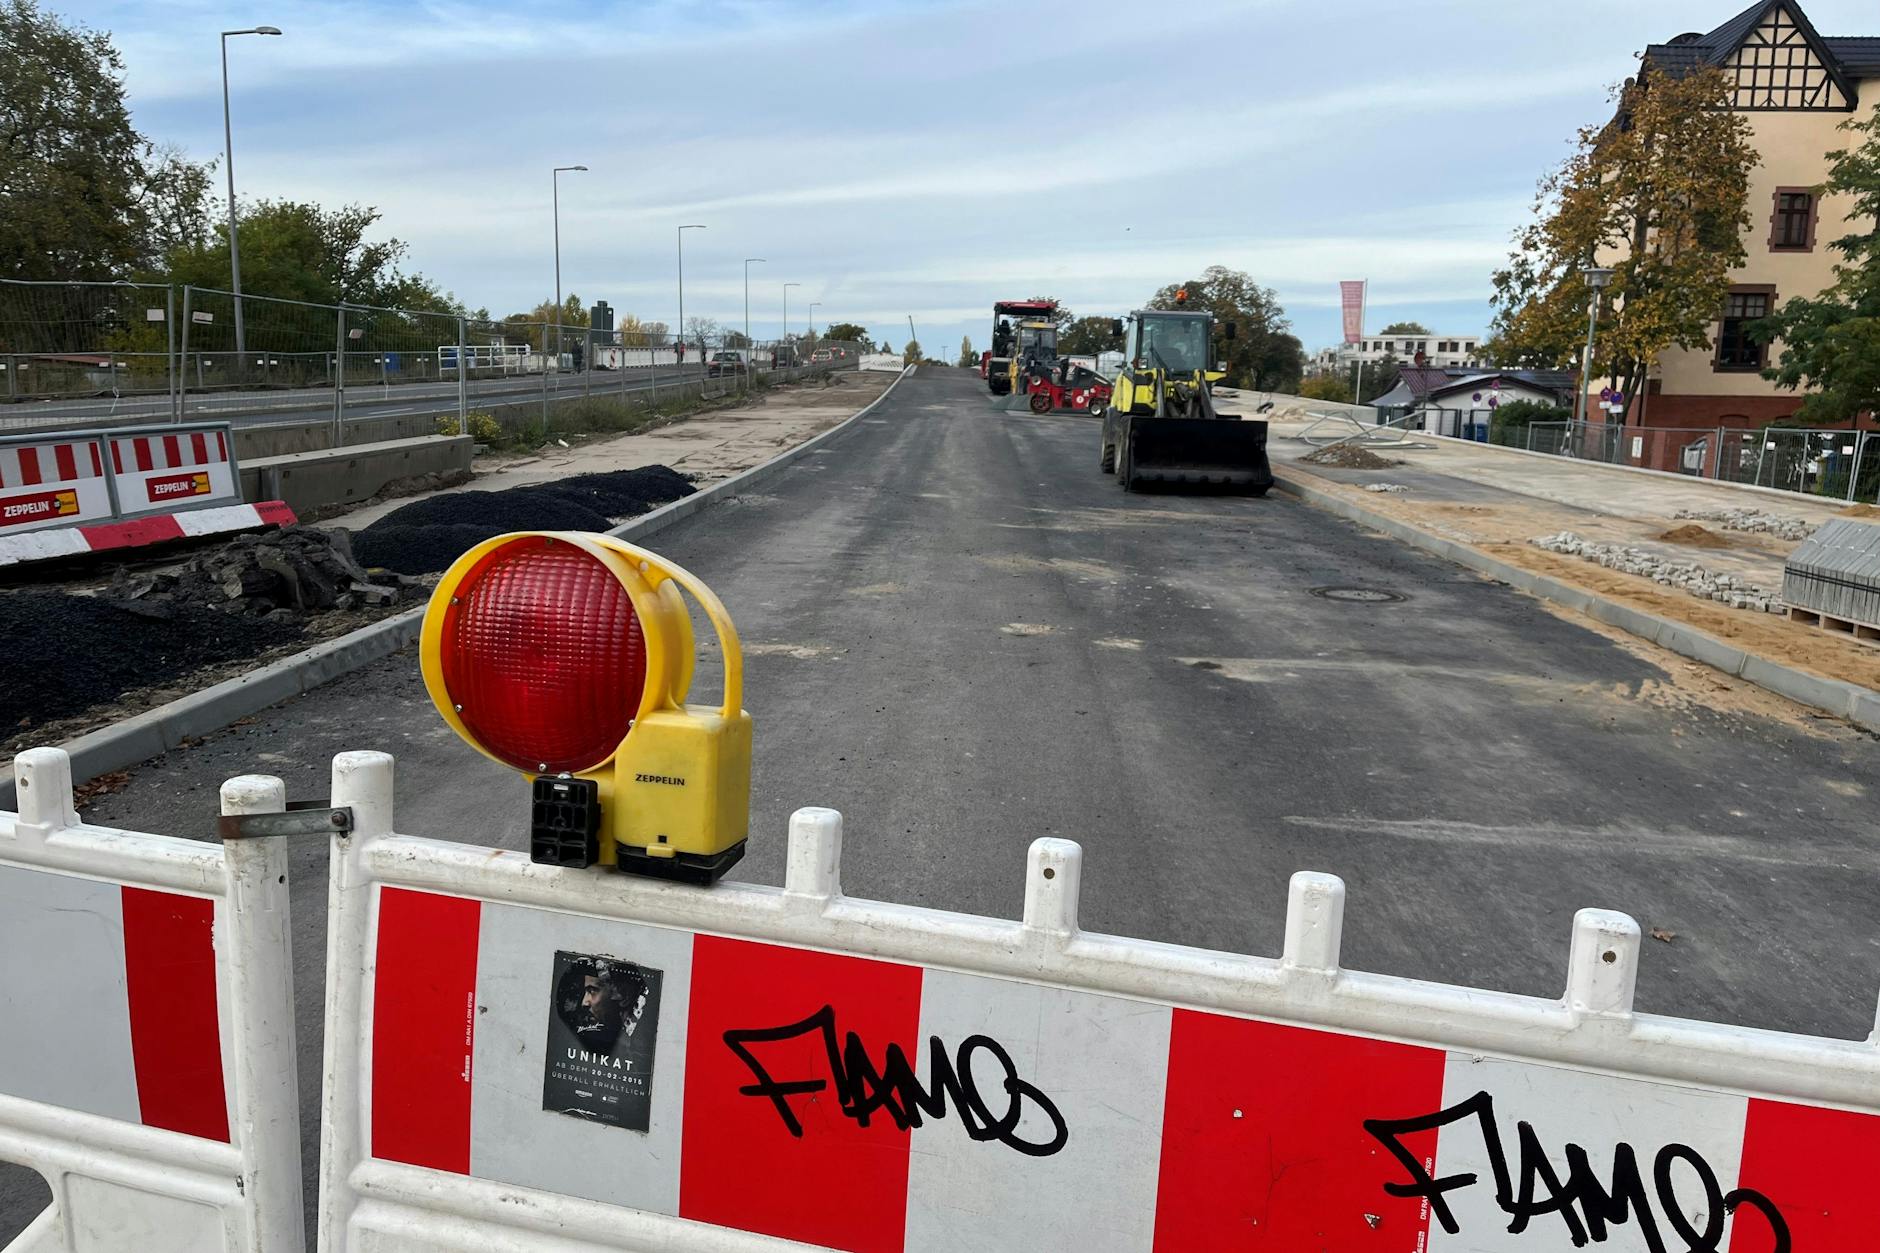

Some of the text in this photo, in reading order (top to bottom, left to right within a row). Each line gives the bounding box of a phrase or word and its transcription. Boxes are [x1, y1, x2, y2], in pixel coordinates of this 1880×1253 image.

[154, 481, 189, 494] ZEPPELIN
[3, 501, 50, 518] ZEPPELIN
[635, 774, 685, 786] ZEPPELIN
[567, 1048, 633, 1071] UNIKAT
[570, 1065, 588, 1073] DEM
